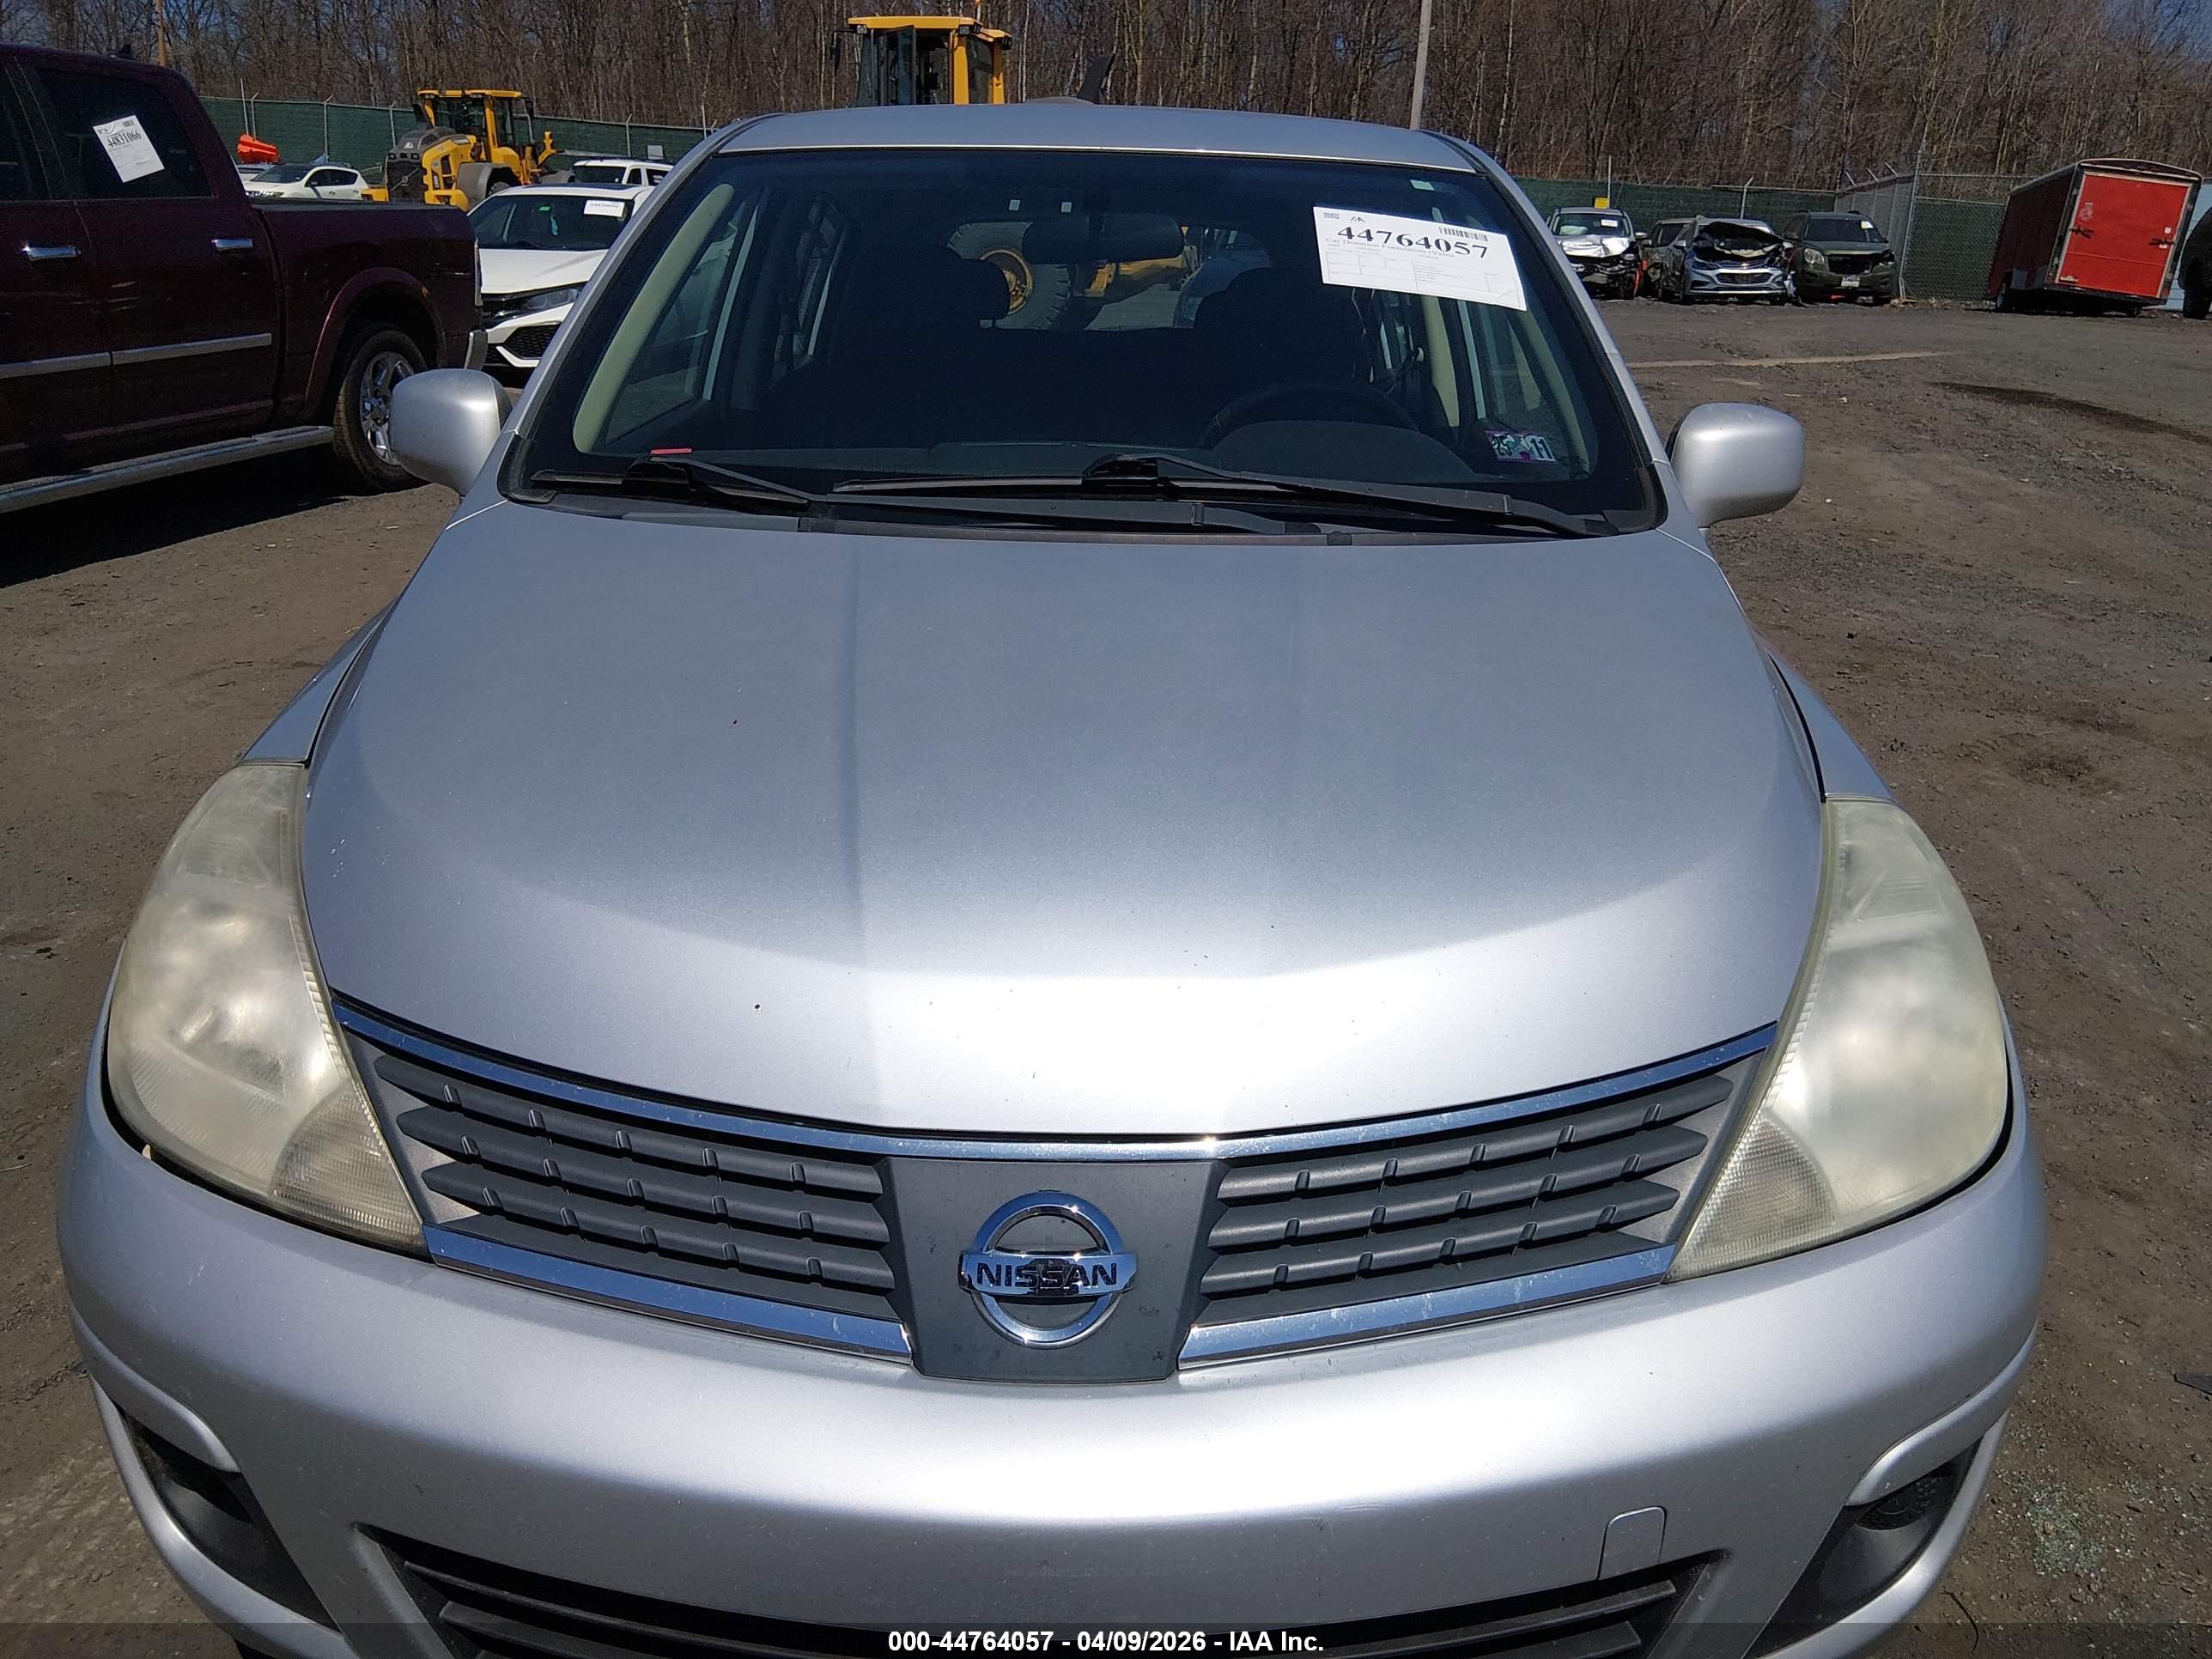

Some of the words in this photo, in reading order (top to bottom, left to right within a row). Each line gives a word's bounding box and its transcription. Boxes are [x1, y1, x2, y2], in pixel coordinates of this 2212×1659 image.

[106, 129, 142, 148] 44831066
[1337, 226, 1488, 258] 44764057
[976, 1261, 1118, 1288] NISSAN
